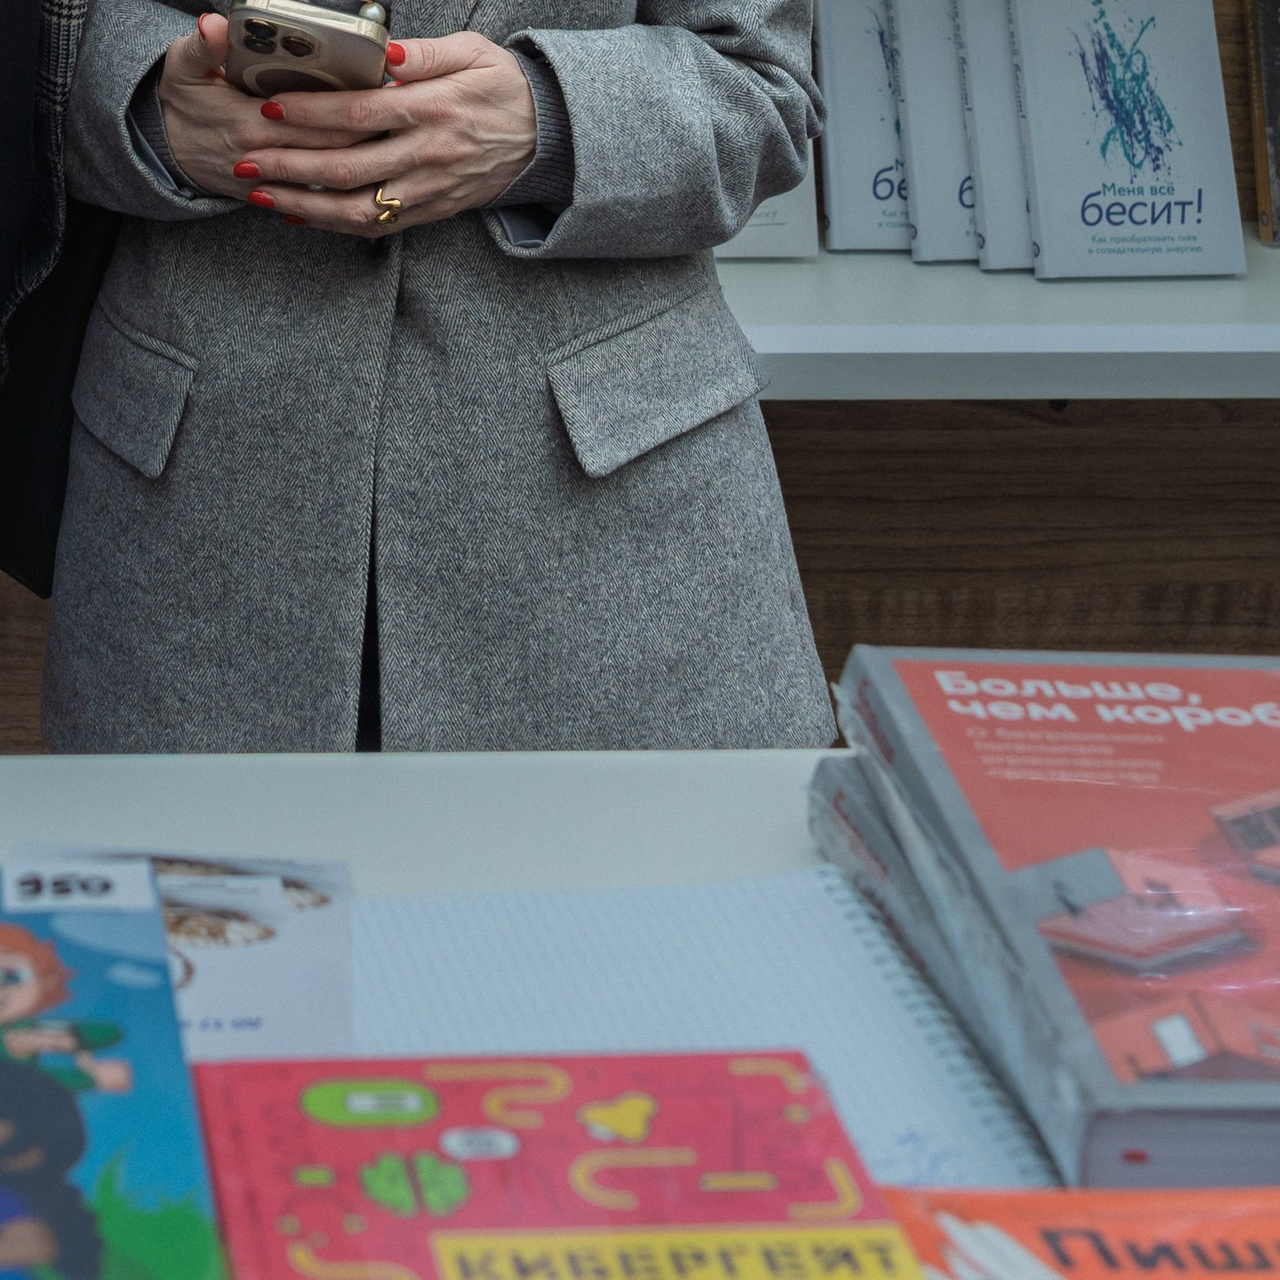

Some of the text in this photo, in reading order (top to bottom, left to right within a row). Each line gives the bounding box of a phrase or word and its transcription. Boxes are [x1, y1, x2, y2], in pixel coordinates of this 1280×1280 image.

[1101, 181, 1175, 197] Меня всё
[1081, 188, 1203, 227] бесит!
[934, 670, 1201, 706] Больше,
[947, 698, 1079, 722] чем
[1040, 1228, 1280, 1272] Пиш
